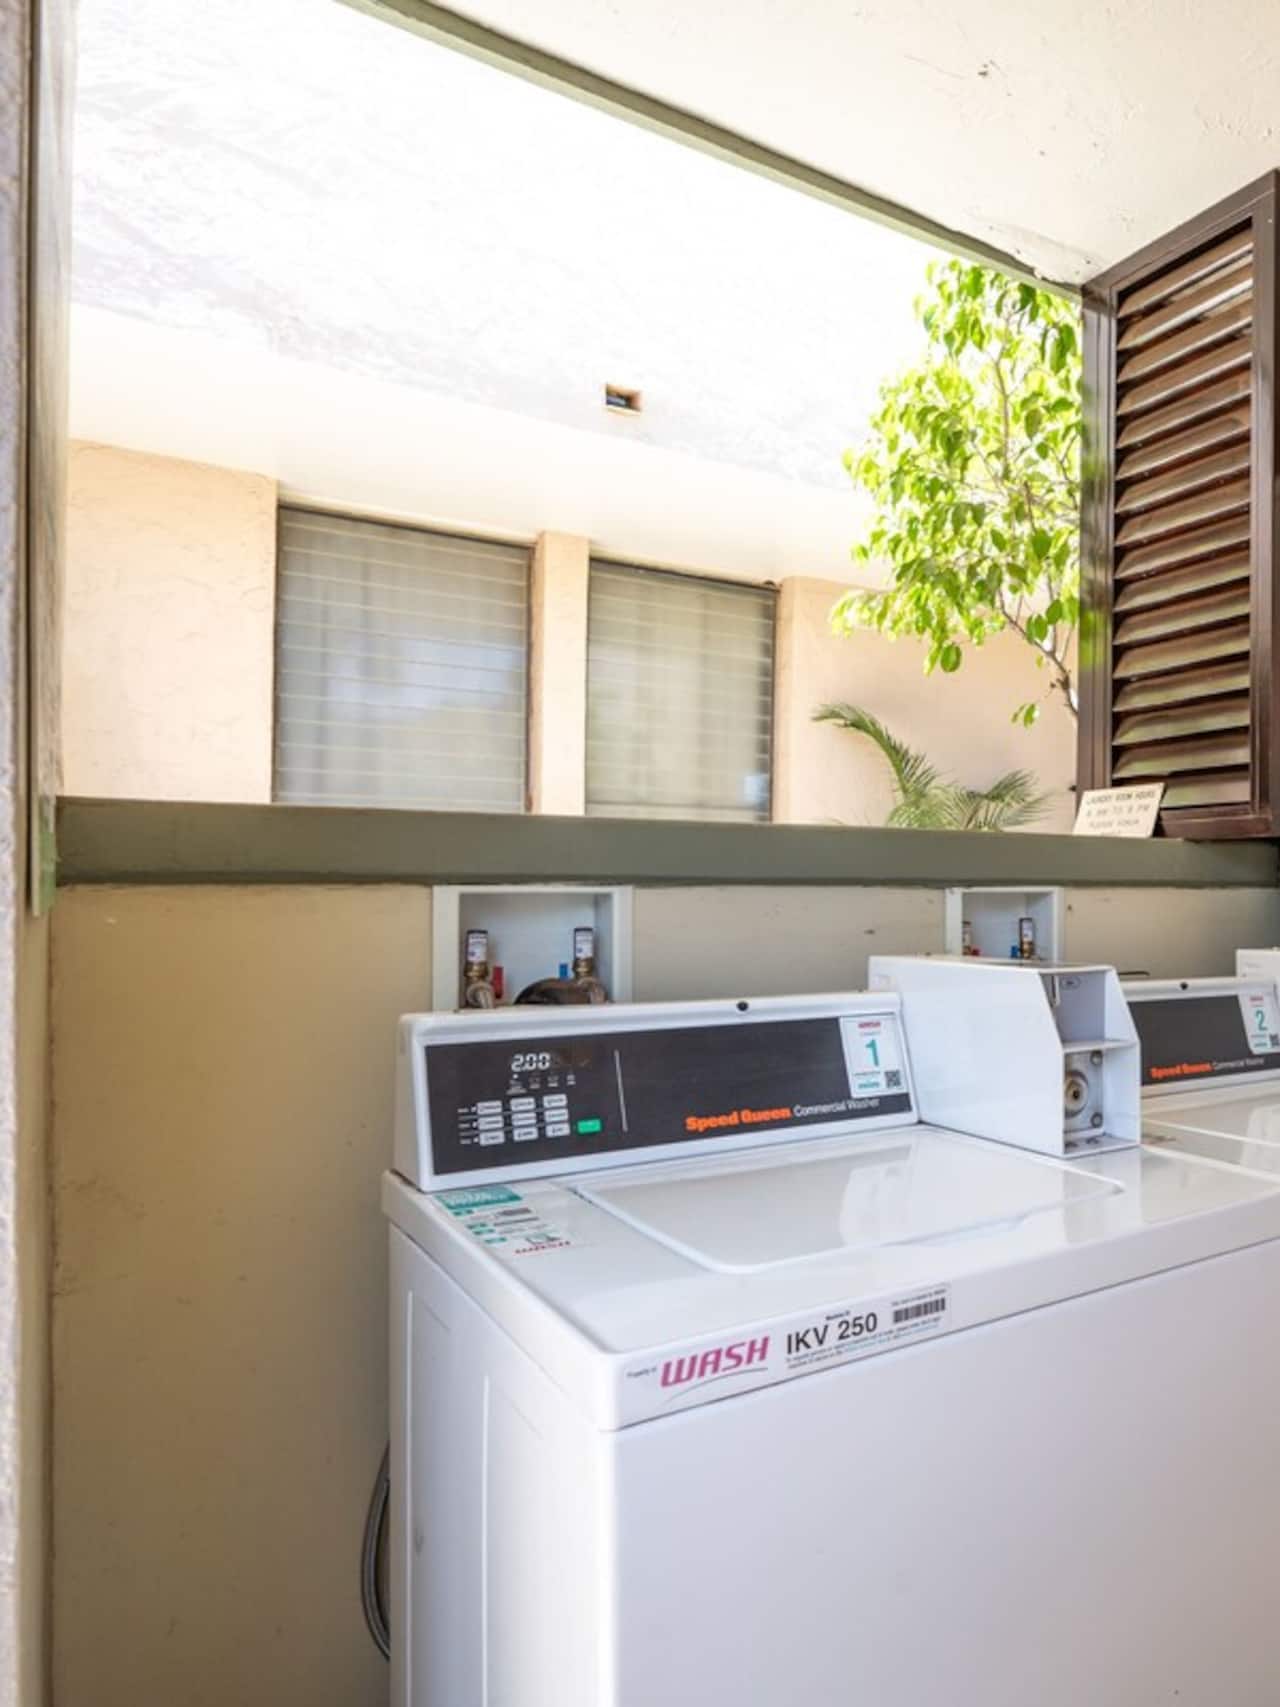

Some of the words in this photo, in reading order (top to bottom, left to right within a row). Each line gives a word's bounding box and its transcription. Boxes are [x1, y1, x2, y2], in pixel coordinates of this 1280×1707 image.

[1255, 1009, 1267, 1031] 2
[864, 1038, 879, 1067] 1
[685, 1110, 740, 1132] Speed
[740, 1106, 792, 1123] Queen
[793, 1101, 847, 1118] Commercial
[847, 1098, 881, 1111] Washer
[786, 1323, 829, 1355] IKV
[837, 1311, 878, 1341] 250
[660, 1335, 770, 1388] WASH
